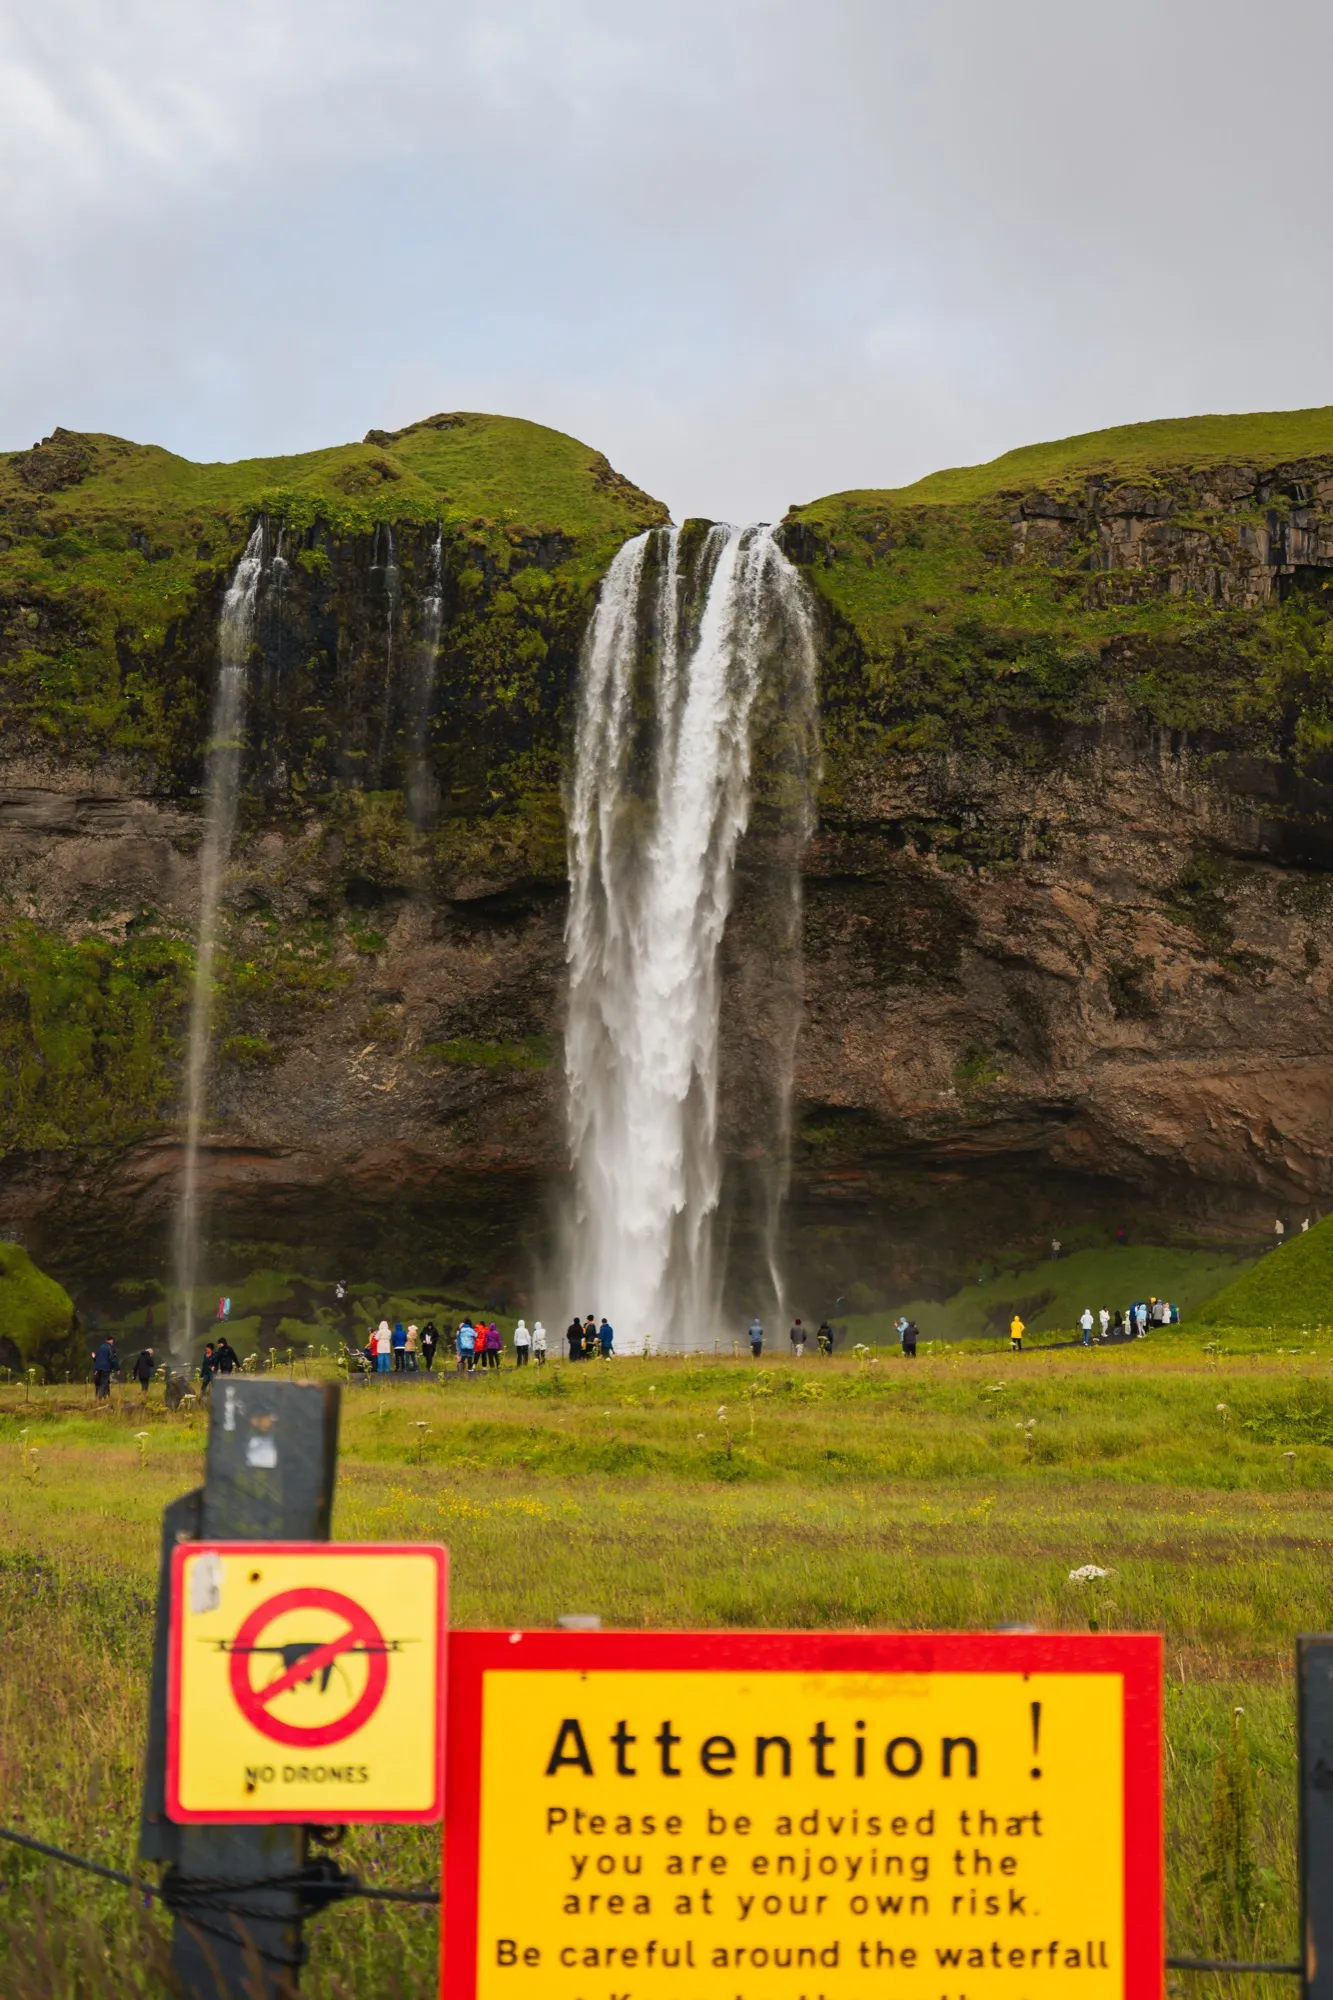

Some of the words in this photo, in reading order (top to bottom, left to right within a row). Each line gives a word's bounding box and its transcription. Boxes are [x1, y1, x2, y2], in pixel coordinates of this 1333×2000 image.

[542, 1717, 980, 1780] Attention
[245, 1765, 276, 1784] NO
[282, 1765, 369, 1783] DRONES
[706, 1807, 753, 1837] be
[774, 1807, 936, 1837] advised
[957, 1808, 1044, 1838] that
[570, 1853, 643, 1882] you
[665, 1853, 729, 1876] are
[750, 1847, 931, 1882] enjoying
[951, 1847, 1019, 1877] the
[562, 1893, 652, 1916] area
[673, 1887, 714, 1916] at
[736, 1893, 829, 1922] your
[848, 1894, 930, 1916] own
[495, 1938, 542, 1968] Be
[558, 1938, 697, 1969] careful
[710, 1938, 841, 1969] around
[856, 1939, 919, 1969] the
[933, 1939, 1110, 1969] waterfall
